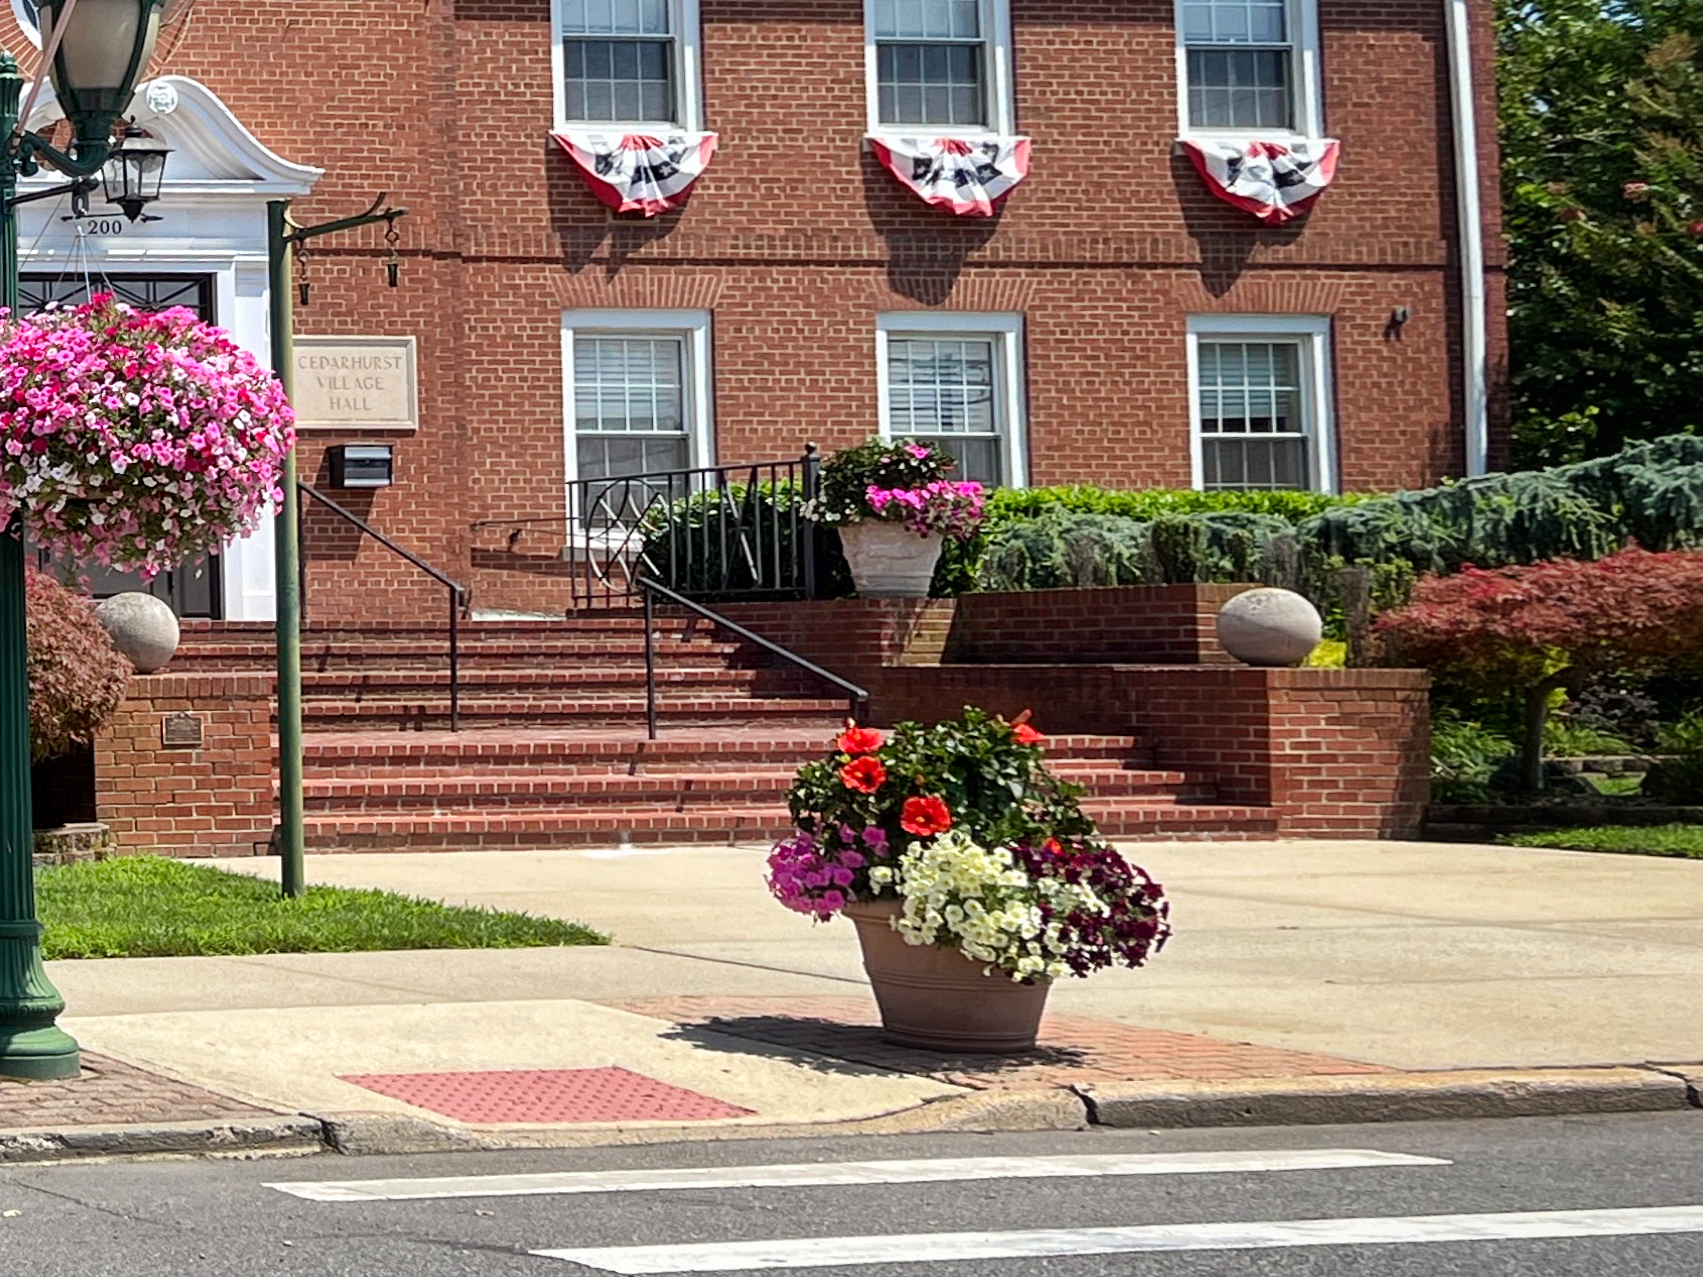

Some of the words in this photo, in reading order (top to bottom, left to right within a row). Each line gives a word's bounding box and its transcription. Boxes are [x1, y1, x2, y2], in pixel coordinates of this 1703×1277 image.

[87, 220, 122, 235] 200
[297, 355, 403, 370] CEDARHURST
[316, 376, 385, 391] VILLAGE
[329, 396, 372, 411] HALL
